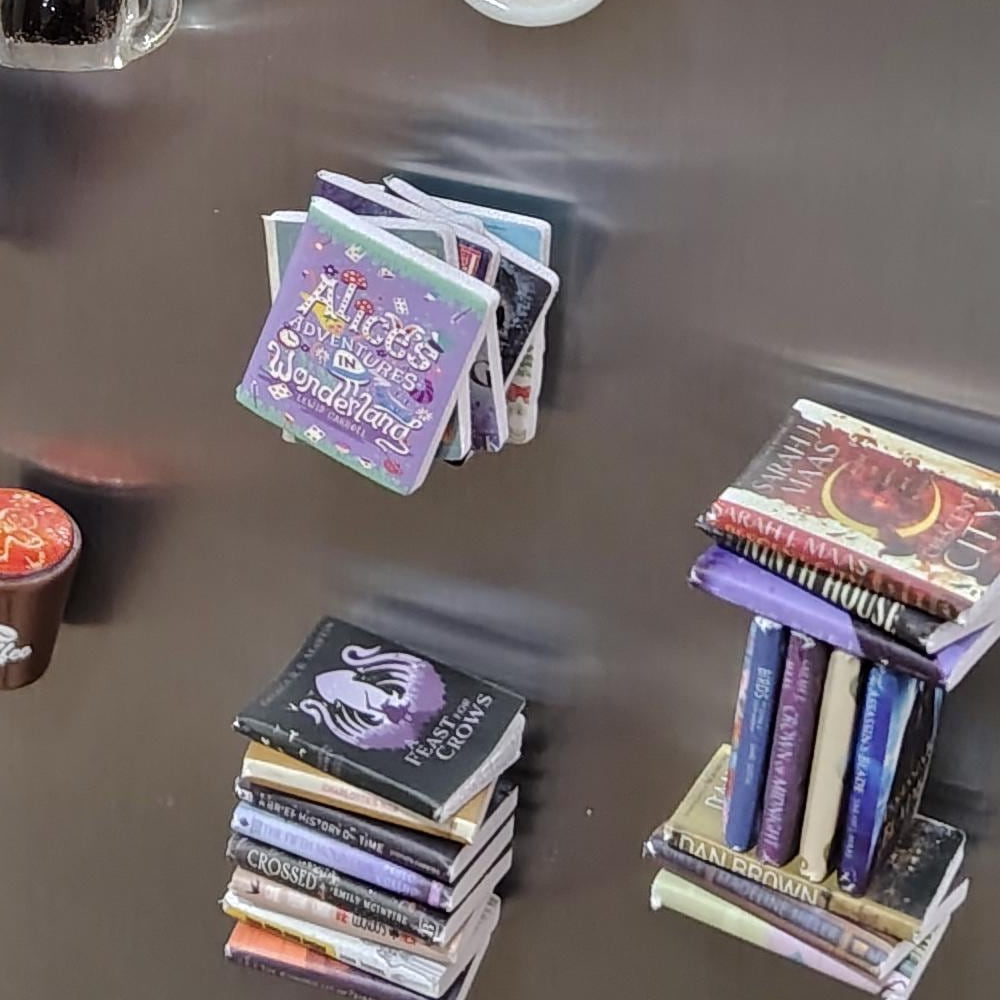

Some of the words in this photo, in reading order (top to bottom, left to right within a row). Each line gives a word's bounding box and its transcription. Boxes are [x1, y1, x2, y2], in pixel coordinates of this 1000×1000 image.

[288, 315, 418, 392] ADVENTURES
[337, 354, 357, 370] IN
[752, 424, 812, 493] SARAH
[781, 442, 841, 494] MAAS
[713, 499, 783, 540] SARAH
[800, 536, 870, 577] MAAS
[735, 536, 819, 590] NINTH
[821, 573, 906, 634] HOUSE
[404, 715, 458, 767] FEAST
[435, 692, 495, 762] CROWS
[777, 704, 799, 760] CROWN
[853, 754, 870, 794] BLADE
[298, 811, 342, 837] HISTORY
[358, 833, 386, 854] TIME
[764, 775, 788, 849] MIDNIGHT
[247, 849, 318, 891] CROSSED
[730, 851, 820, 906] BROWN
